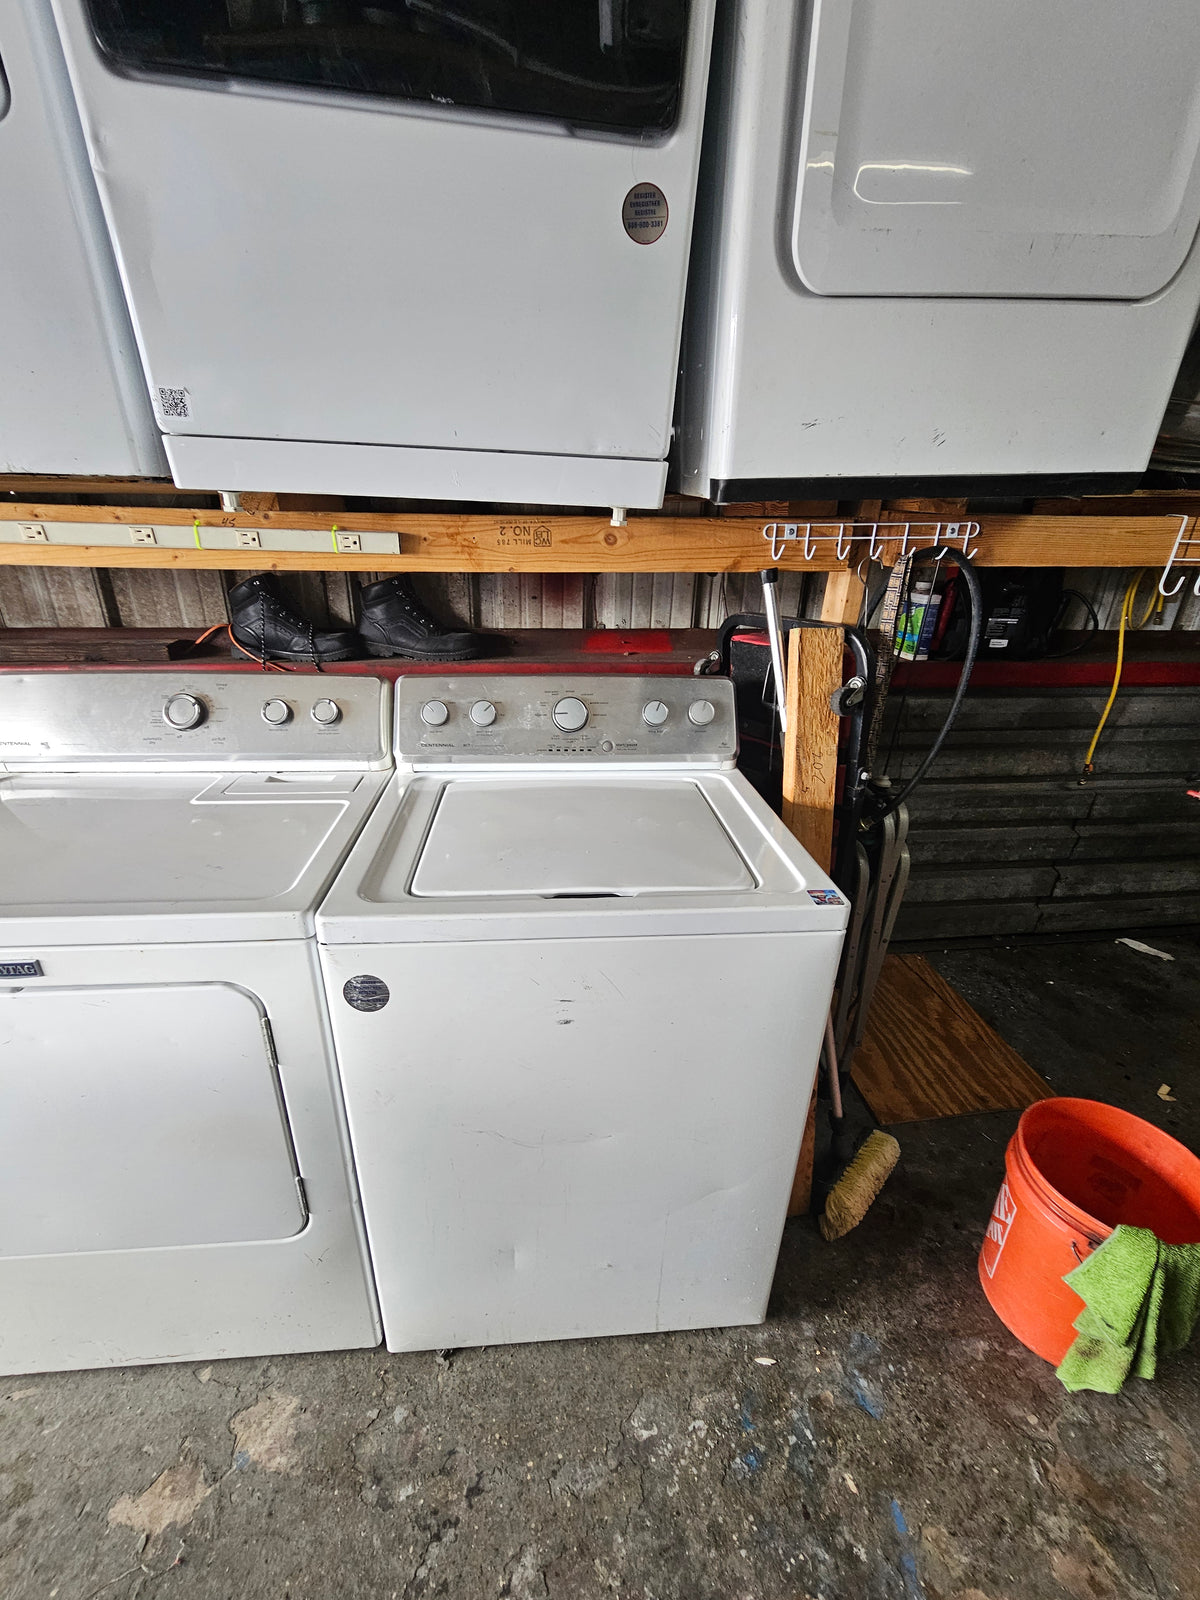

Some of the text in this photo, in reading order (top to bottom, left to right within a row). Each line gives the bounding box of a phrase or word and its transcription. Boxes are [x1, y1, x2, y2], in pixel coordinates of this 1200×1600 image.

[499, 525, 531, 536] NO. 2
[0, 965, 35, 974] YTAG
